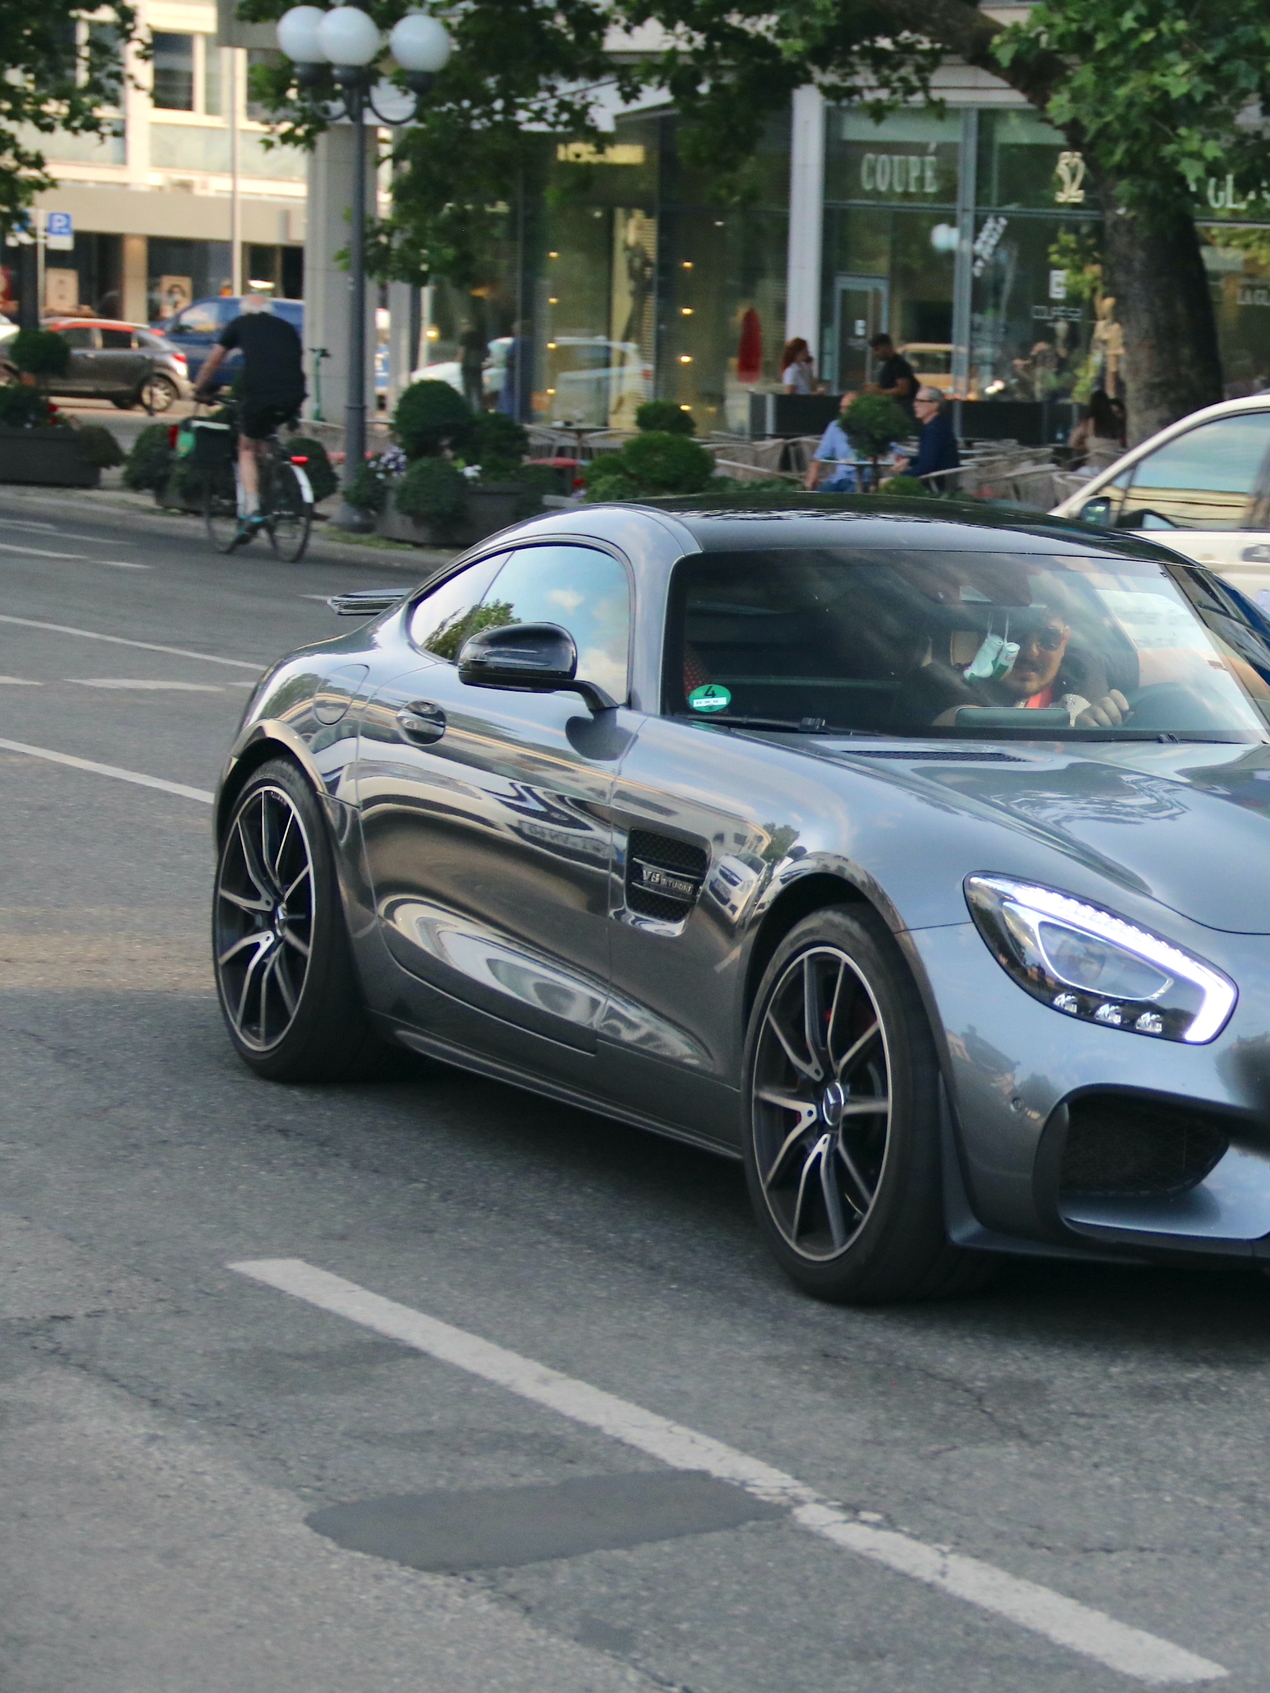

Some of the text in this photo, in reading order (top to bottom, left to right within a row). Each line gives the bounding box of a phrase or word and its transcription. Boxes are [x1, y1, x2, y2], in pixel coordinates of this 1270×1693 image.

[861, 141, 938, 193] COUPÉ
[52, 214, 69, 233] P
[703, 685, 717, 698] 4
